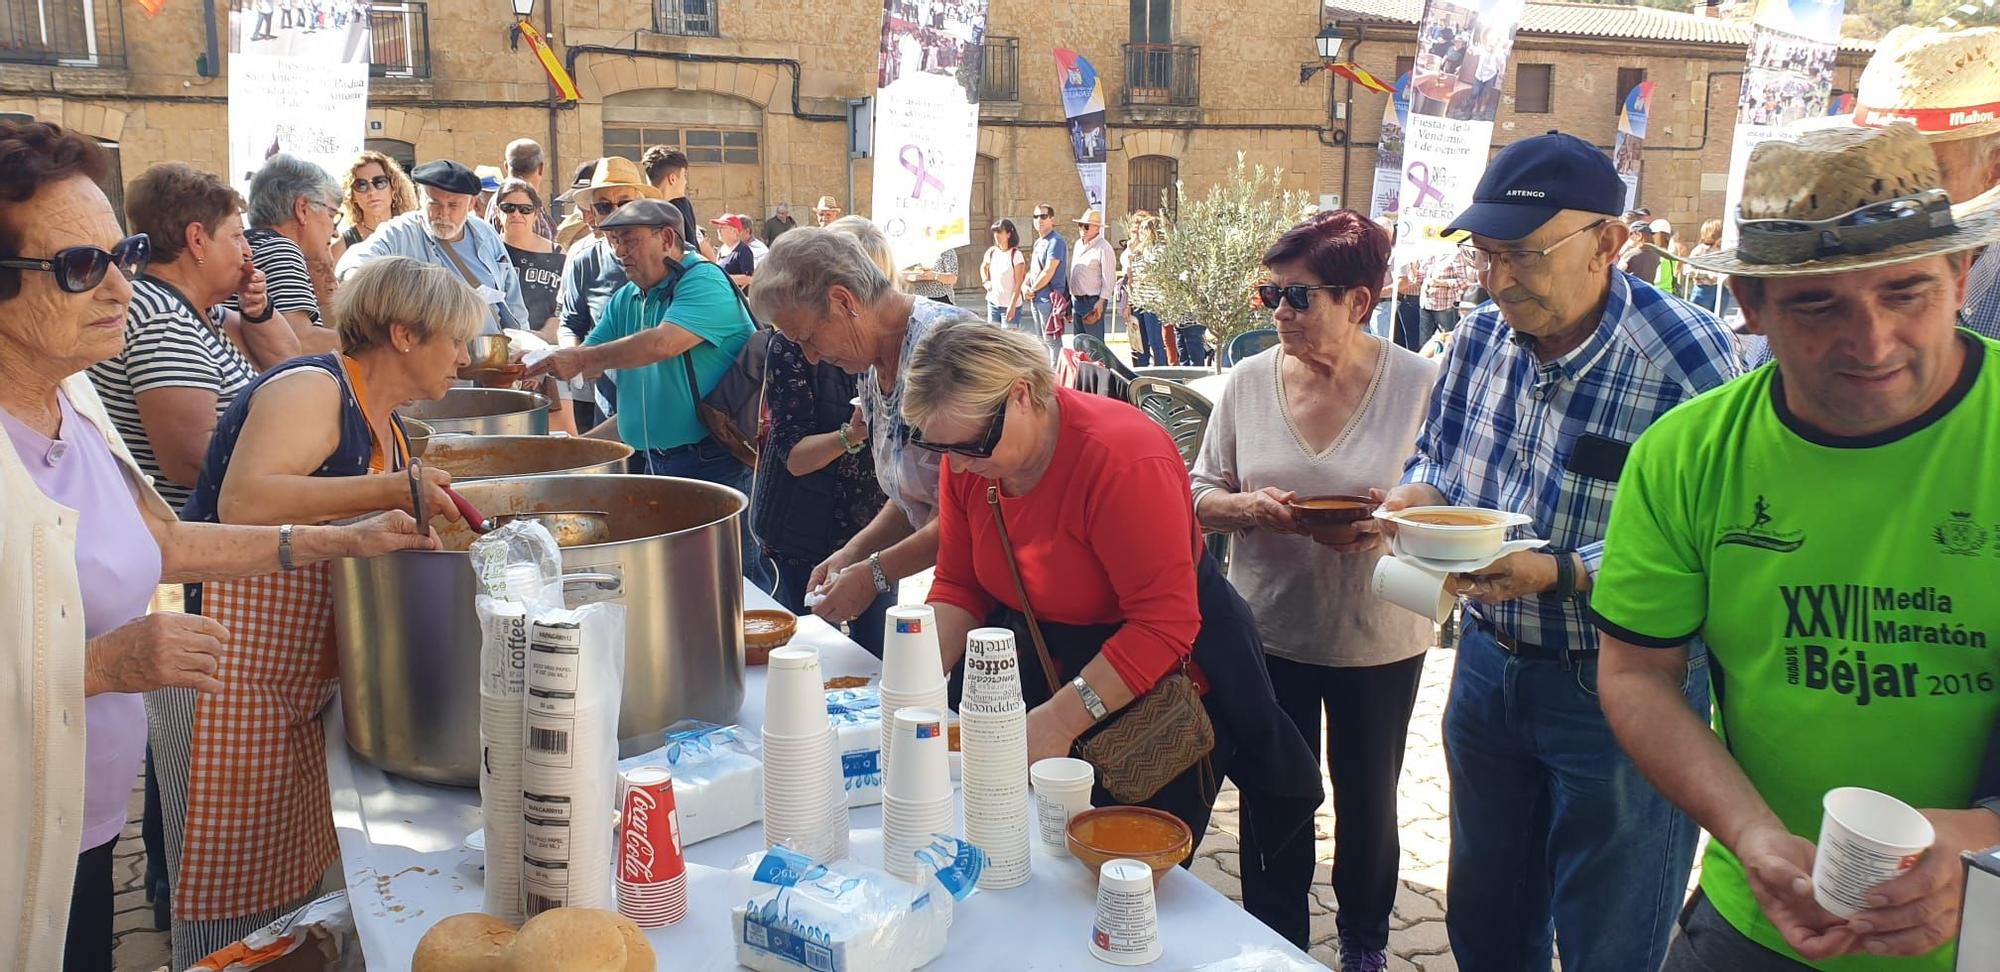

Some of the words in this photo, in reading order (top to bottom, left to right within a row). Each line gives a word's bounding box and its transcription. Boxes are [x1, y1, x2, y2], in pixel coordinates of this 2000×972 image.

[1506, 190, 1545, 198] ARTENGO
[525, 268, 562, 288] OUT
[1779, 584, 1869, 642] XXVII
[1873, 587, 1952, 613] Media
[1874, 621, 1987, 648] Maratón
[969, 640, 985, 656] tea
[968, 657, 1015, 675] coffee
[1803, 645, 1920, 706] Béjar
[1926, 672, 1994, 696] 2016
